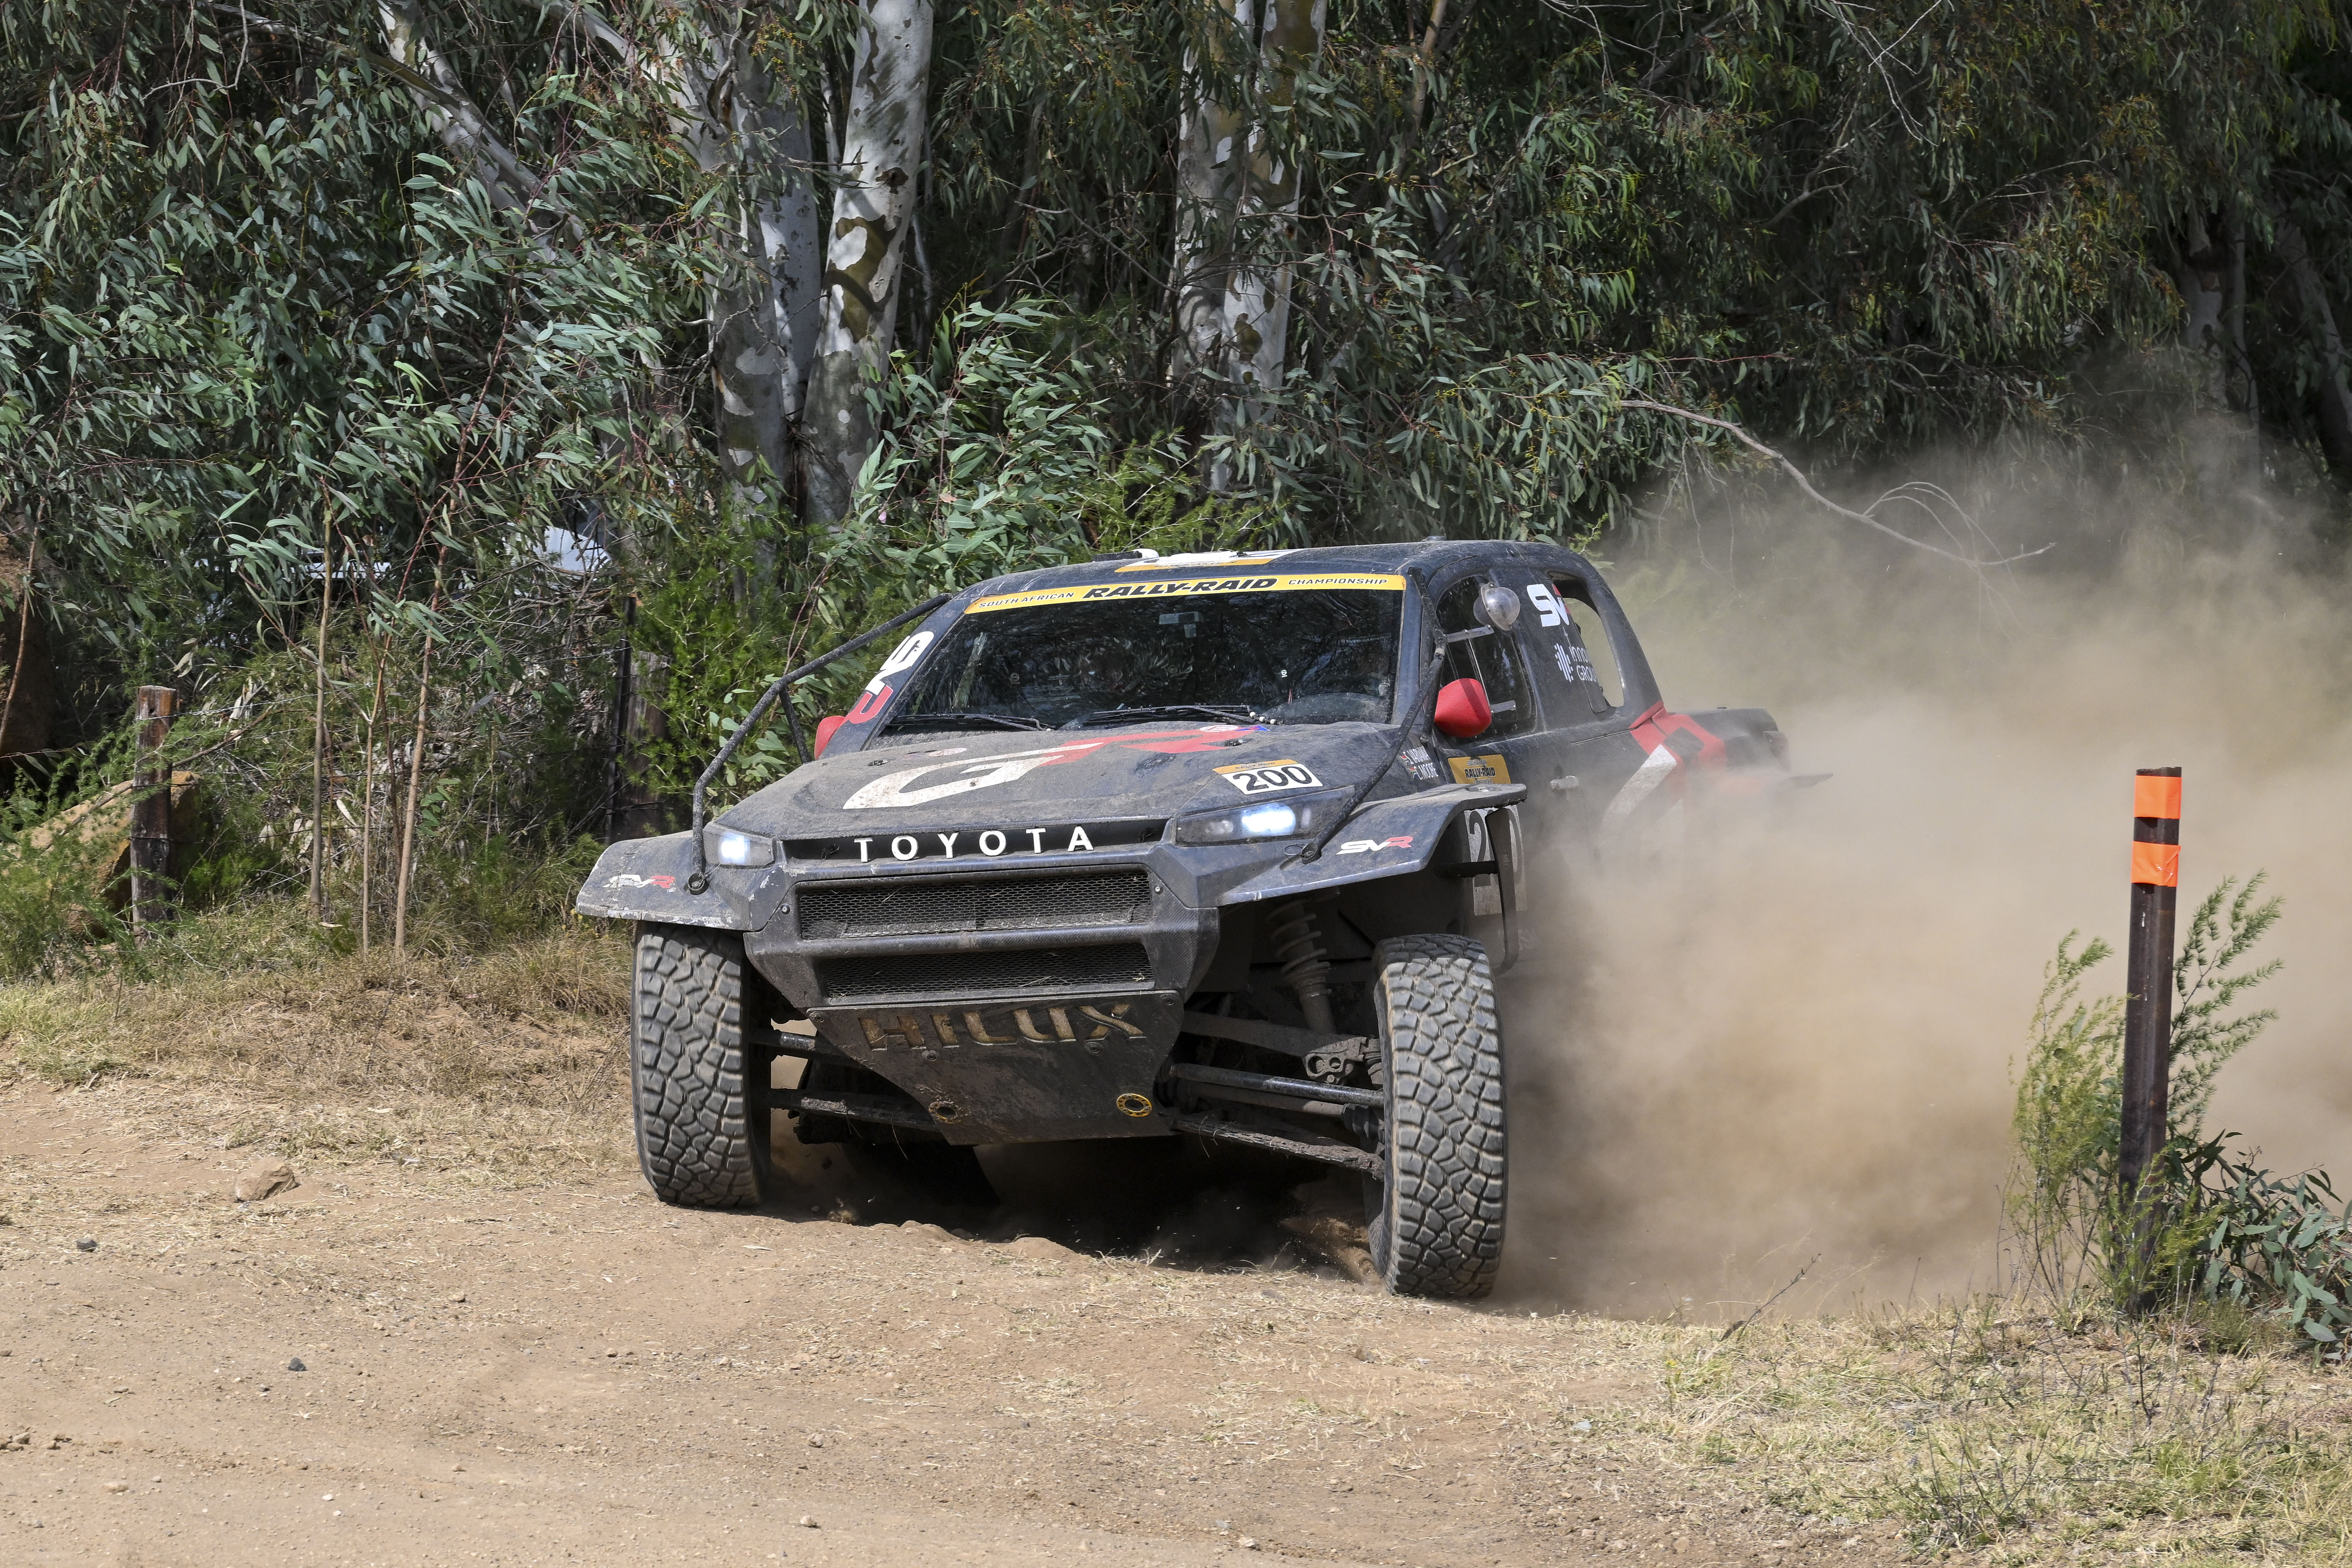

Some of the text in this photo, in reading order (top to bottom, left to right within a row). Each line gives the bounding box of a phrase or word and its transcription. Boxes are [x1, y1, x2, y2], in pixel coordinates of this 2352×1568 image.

[978, 598, 1018, 607] SOUTH
[1021, 592, 1074, 602] AFRICAN
[1083, 578, 1277, 598] RALLY-RAID
[1233, 766, 1312, 791] 200
[1464, 767, 1496, 778] RALLY-RAID
[854, 825, 1094, 862] TOYOTA
[1336, 836, 1413, 855] SVR
[858, 1003, 1147, 1051] HILUX
